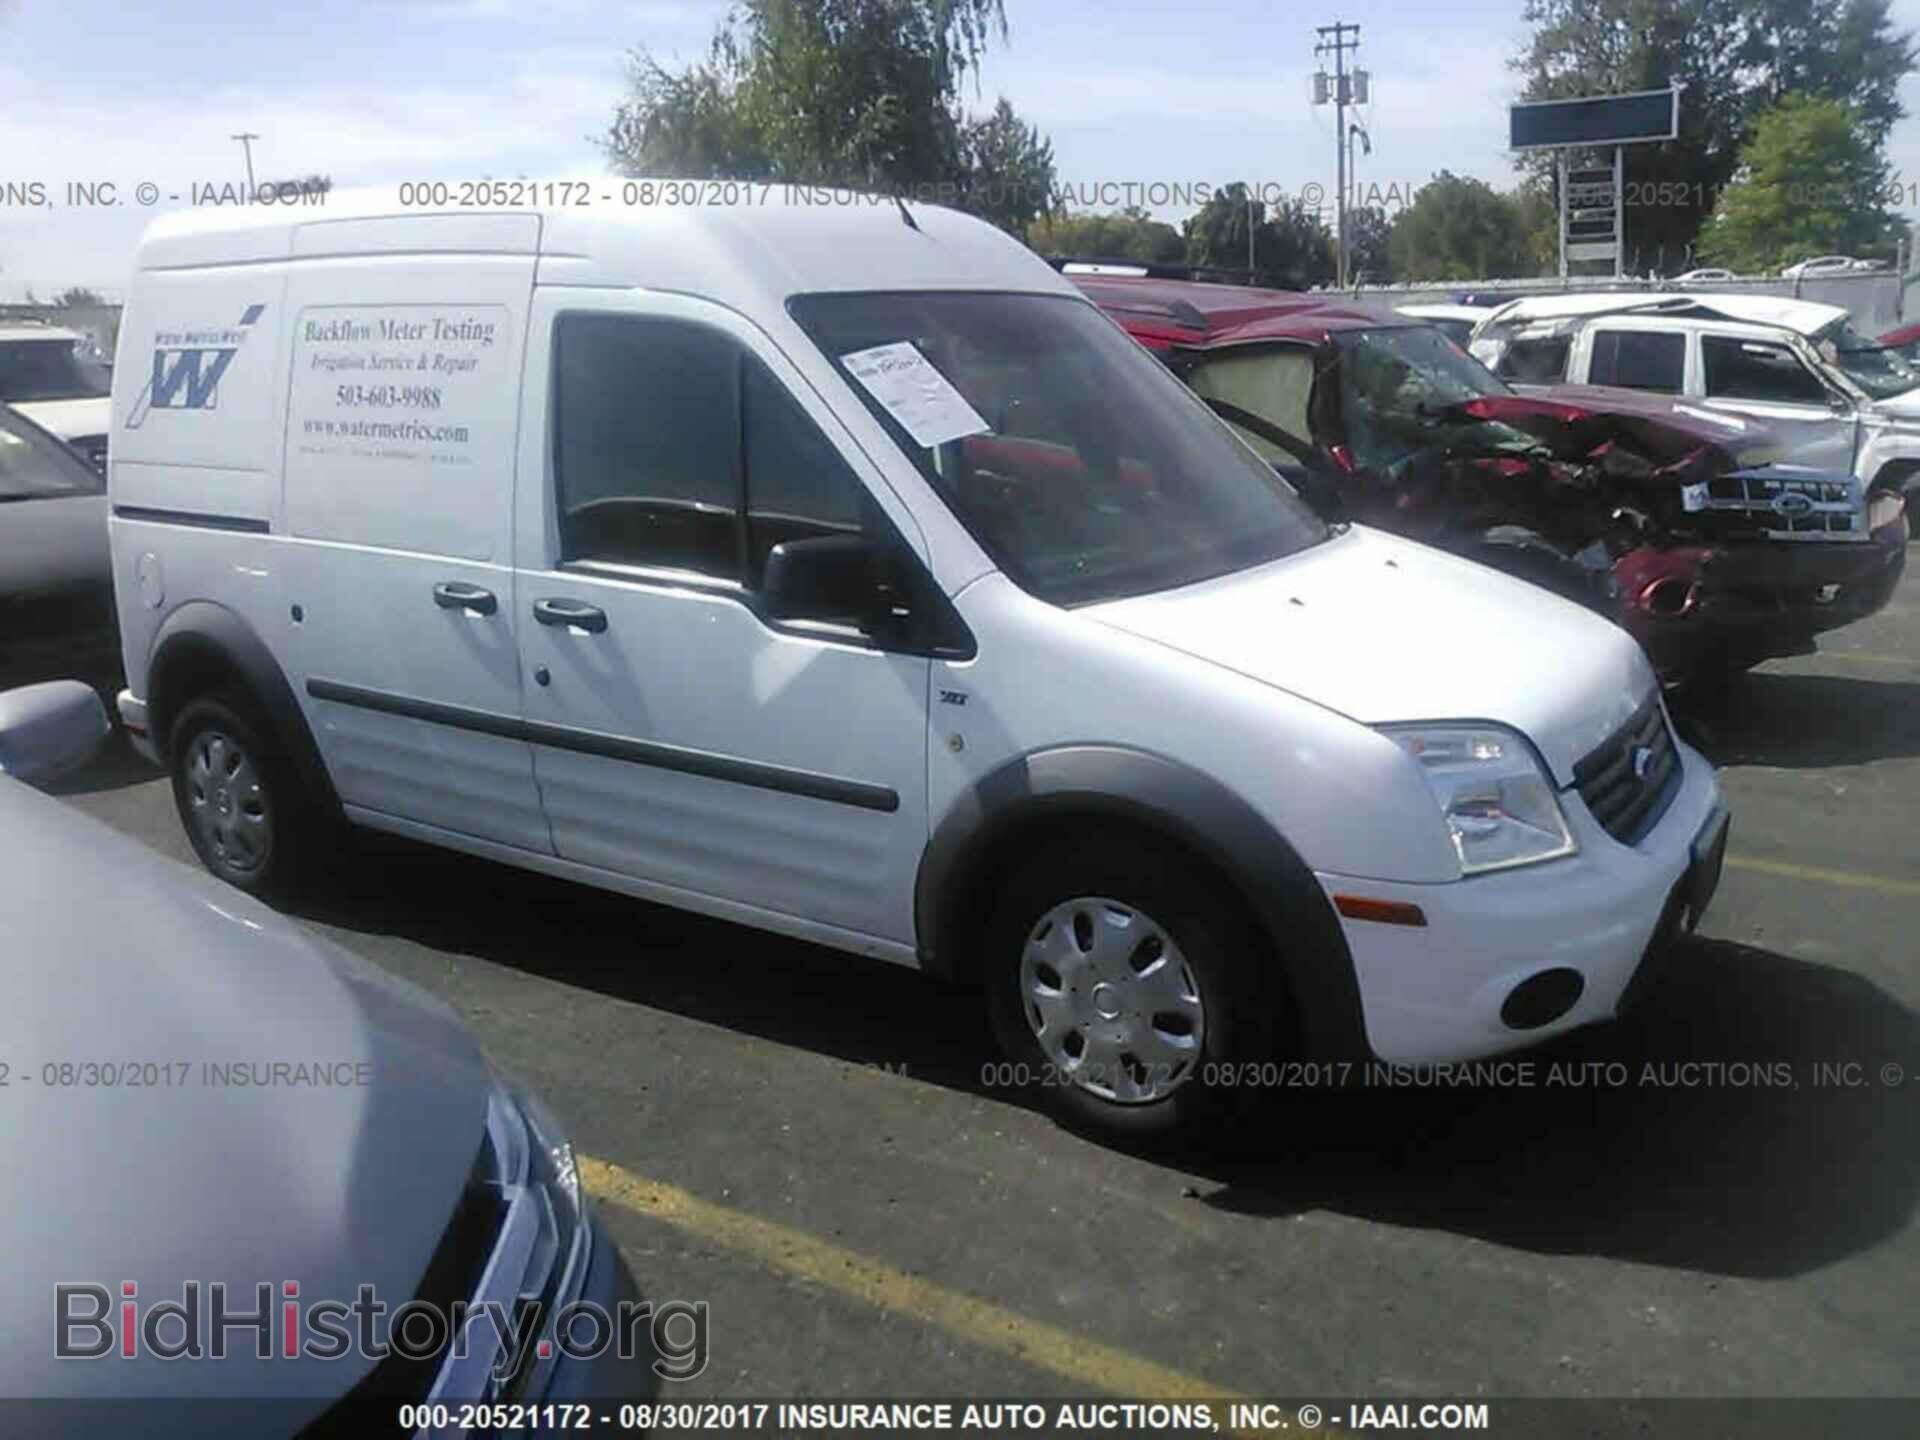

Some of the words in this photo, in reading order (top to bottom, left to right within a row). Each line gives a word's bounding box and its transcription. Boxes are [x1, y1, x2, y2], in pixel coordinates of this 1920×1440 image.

[305, 318, 371, 342] Backflow
[379, 319, 428, 341] Meter
[430, 317, 495, 346] Testing
[369, 354, 414, 371] Service
[416, 354, 428, 370] &
[431, 354, 480, 374] Repair
[335, 385, 442, 409] 503-603-9988
[303, 417, 469, 443] www.watermetrics.com
